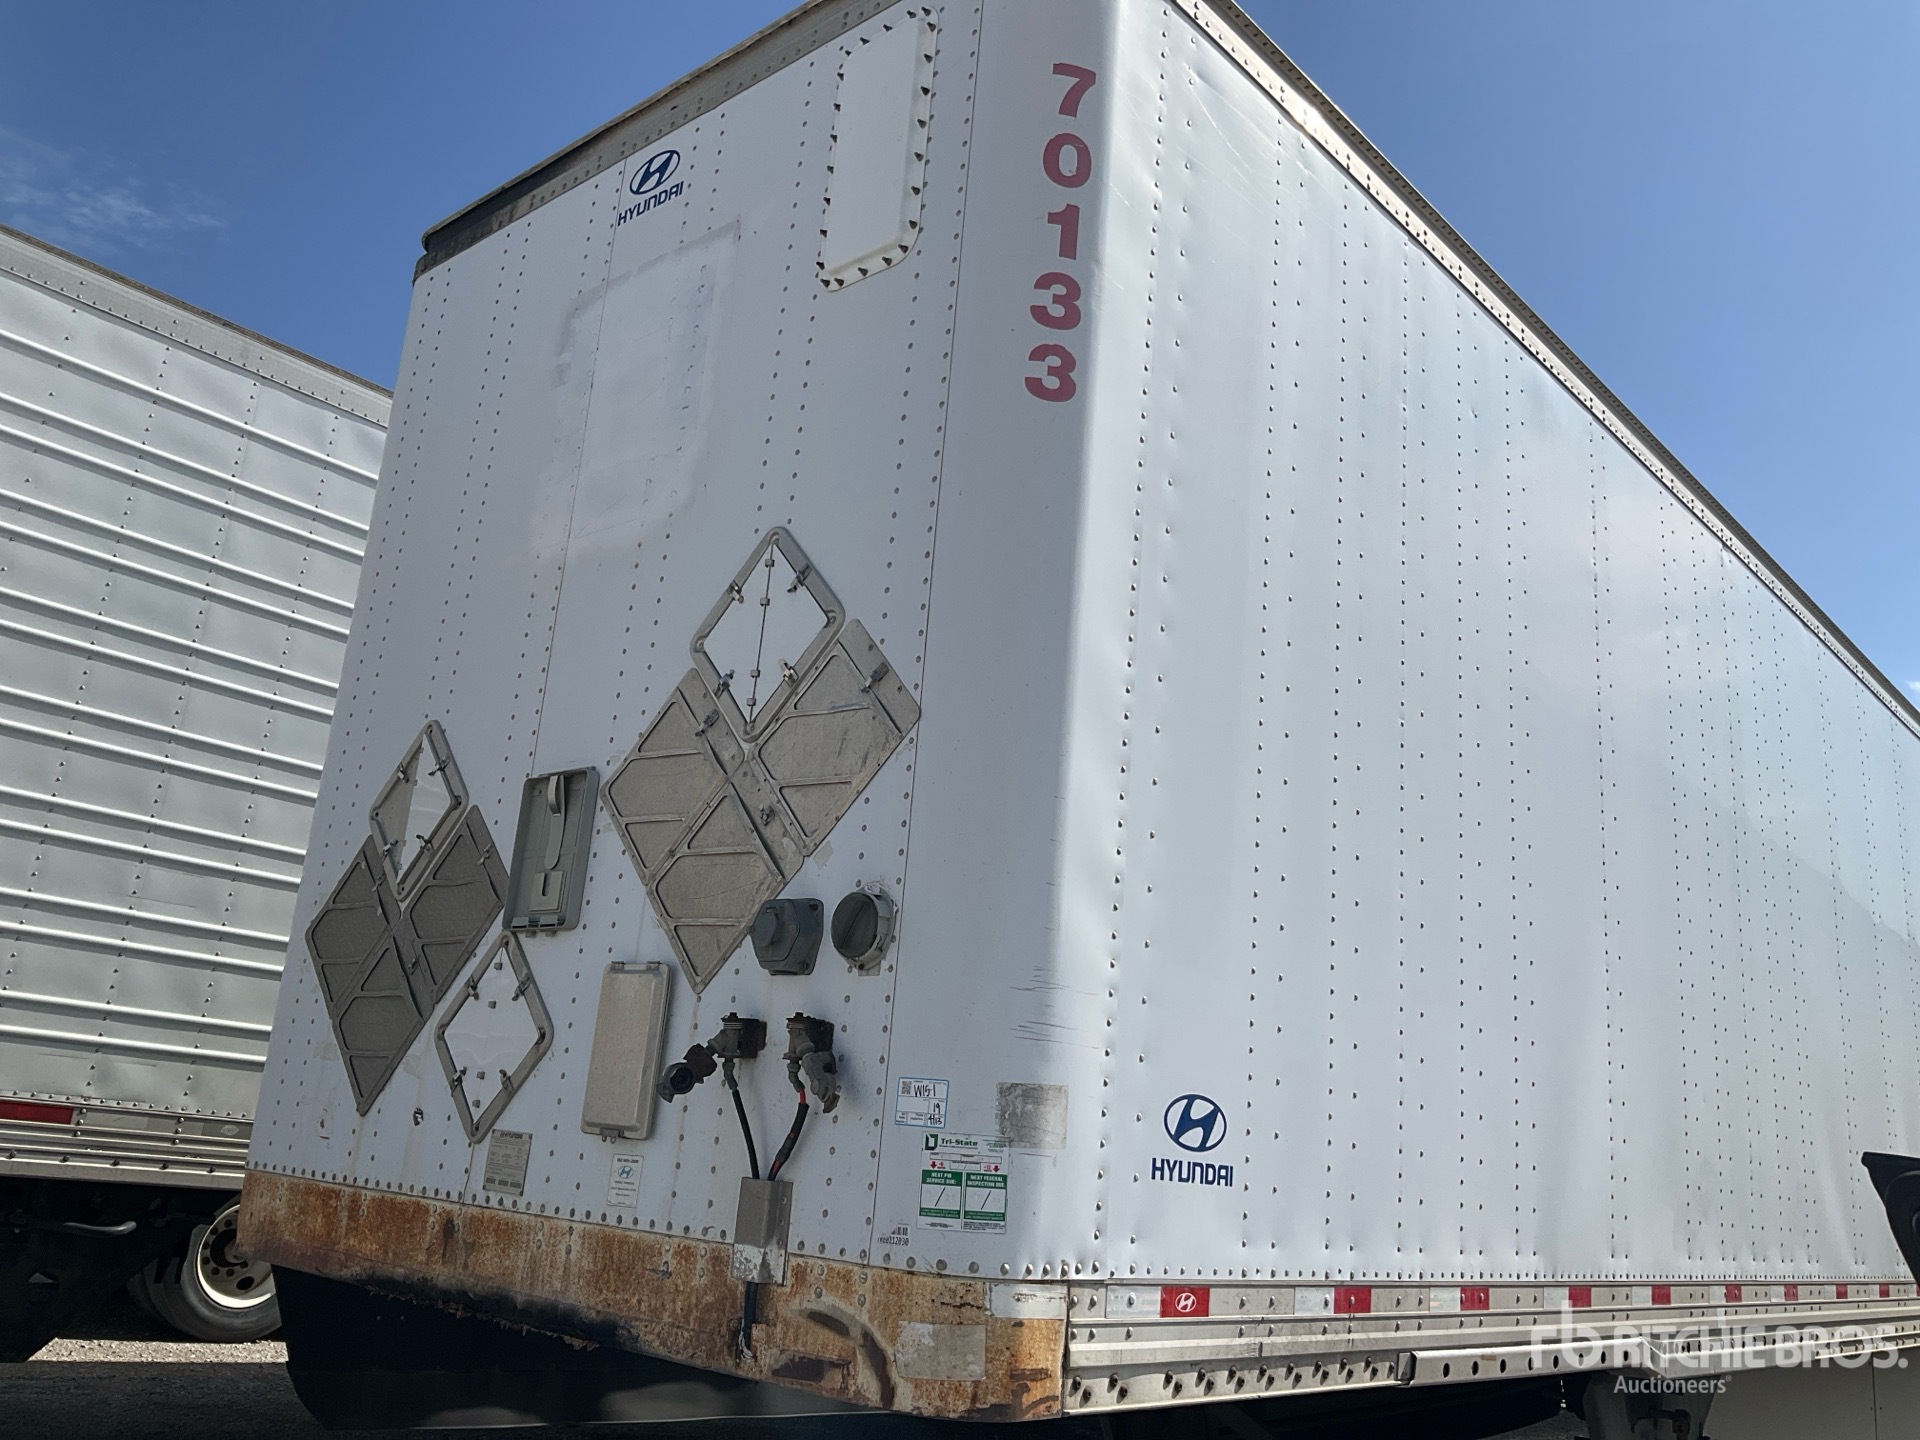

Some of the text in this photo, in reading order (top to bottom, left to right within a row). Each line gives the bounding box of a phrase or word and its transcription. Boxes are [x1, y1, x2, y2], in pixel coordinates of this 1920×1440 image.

[617, 180, 684, 227] HYUNDAI
[1024, 62, 1097, 403] 70133
[940, 1137, 978, 1147] Tri-State
[1151, 1157, 1234, 1187] HYUNDAI
